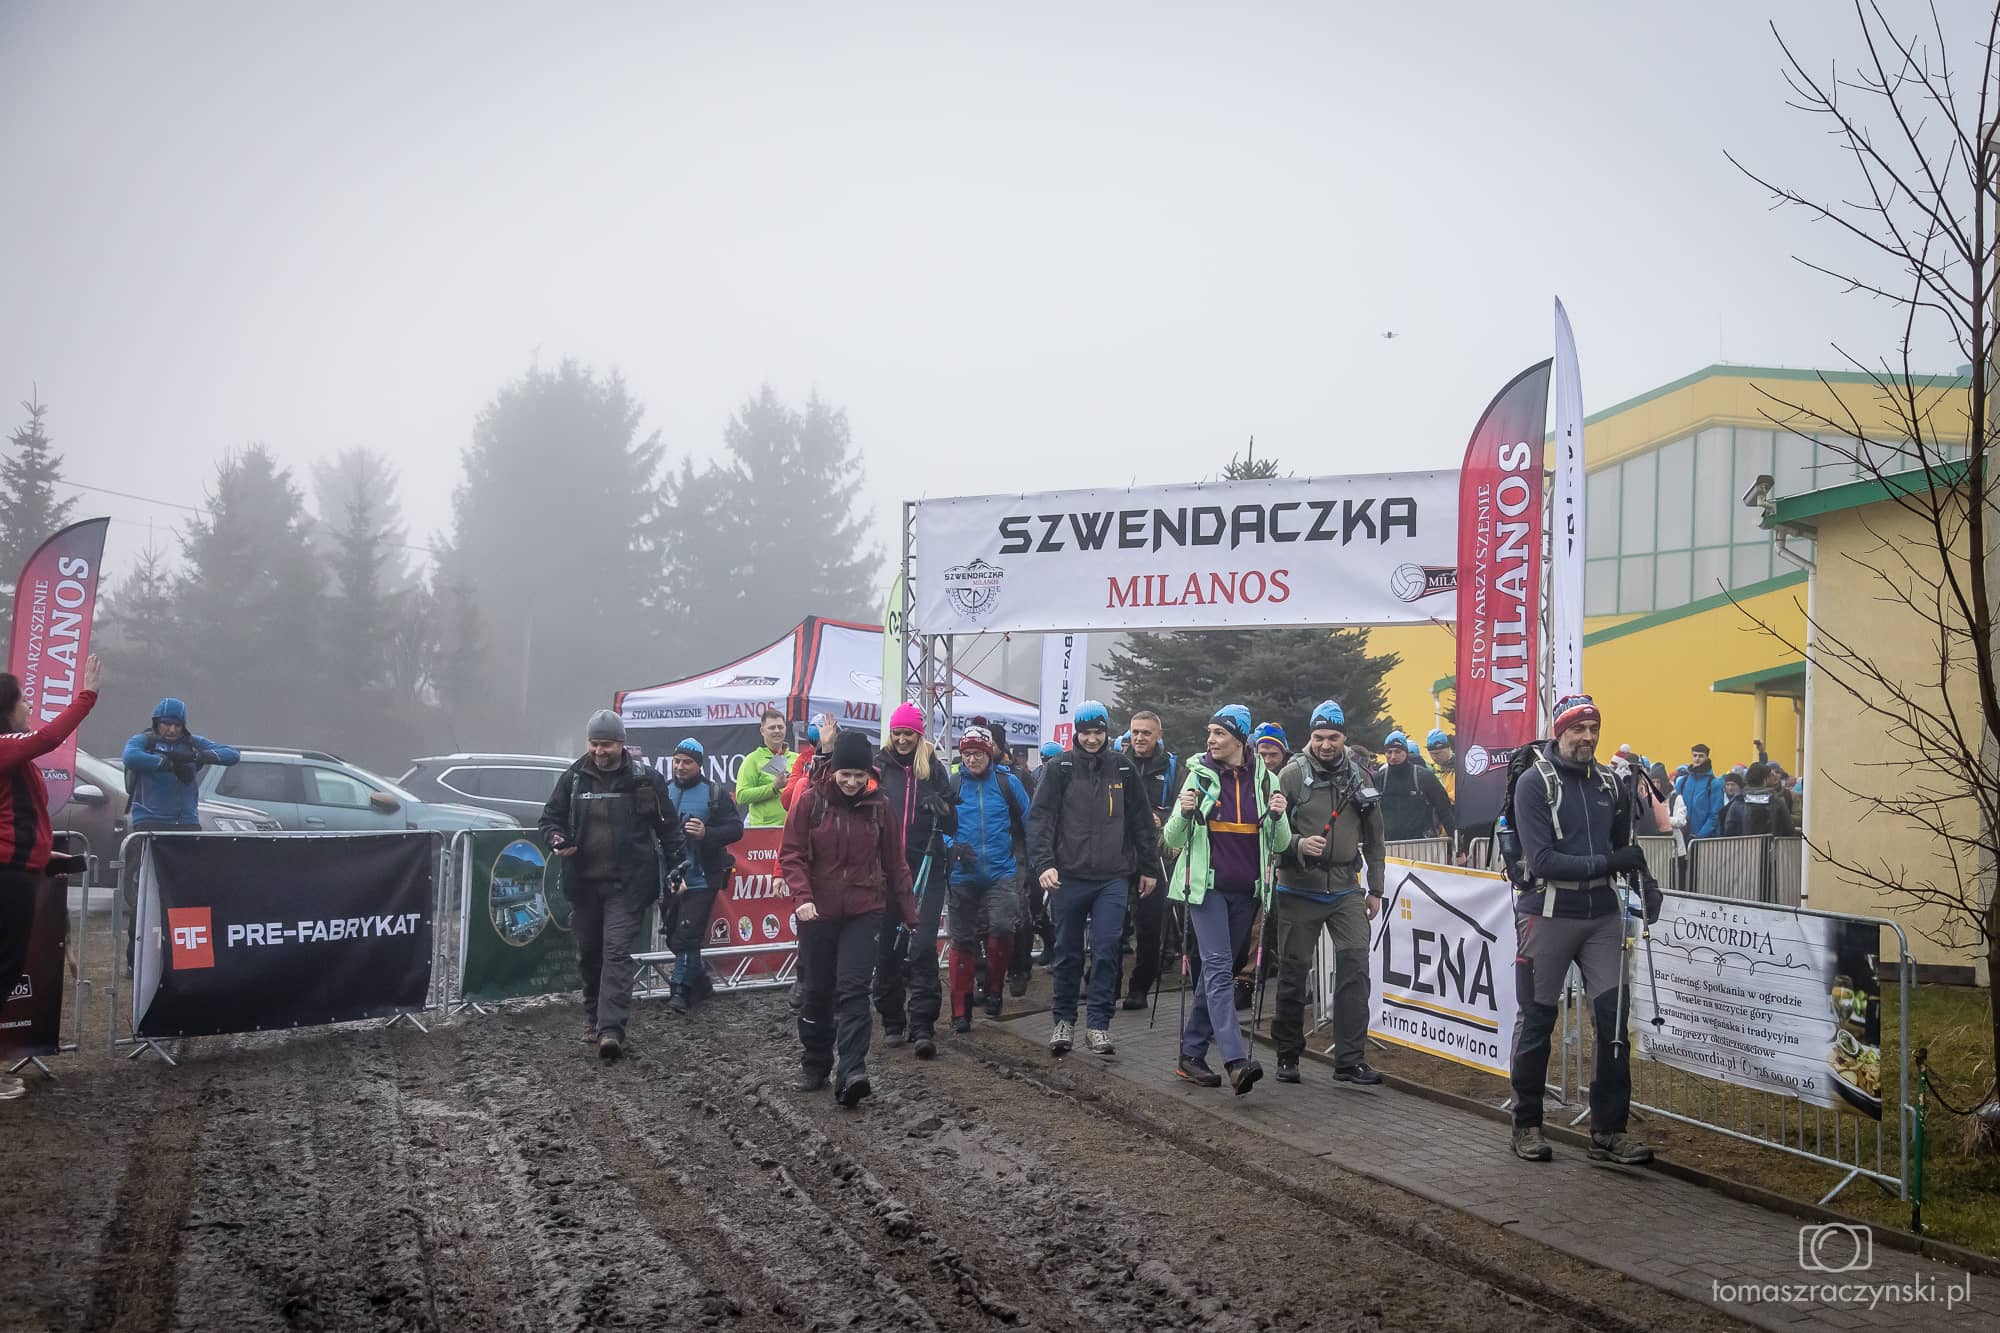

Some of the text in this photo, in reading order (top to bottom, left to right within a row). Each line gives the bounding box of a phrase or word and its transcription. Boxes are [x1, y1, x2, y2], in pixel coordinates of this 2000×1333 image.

[999, 497, 1417, 554] SZWENDACZKA
[944, 571, 1004, 581] SZWENDACZKA
[1106, 569, 1291, 609] MILANOS
[1429, 575, 1457, 588] MILA
[1471, 482, 1490, 680] STOWARZYSZENIE
[1491, 440, 1534, 716] MILANOS
[22, 580, 49, 716] TOWARZYSZENIE
[1060, 635, 1073, 715] PRE-FAB
[632, 707, 702, 720] STOWARZYSZENIE
[1011, 722, 1040, 735] SPOR
[227, 913, 421, 948] PRE-FABRYKAT
[1674, 916, 1775, 955] CONCORDIA
[1700, 909, 1748, 925] HOTEL
[1381, 897, 1498, 1011] LENA
[1675, 991, 1773, 1023] Wesele na szczycie góry
[1703, 980, 1745, 998] Spotkania
[1747, 991, 1756, 1000] w
[1759, 991, 1802, 1008] ogrodzie
[1382, 1010, 1498, 1059] Firma Budowlana
[1672, 1026, 1708, 1043] Imprezy
[1702, 1015, 1740, 1032] wegańska
[1741, 1023, 1745, 1034] i
[1747, 1027, 1799, 1045] tradycyjna
[1652, 1038, 1815, 1089] hotelconcordia.pl 726 00 00 26
